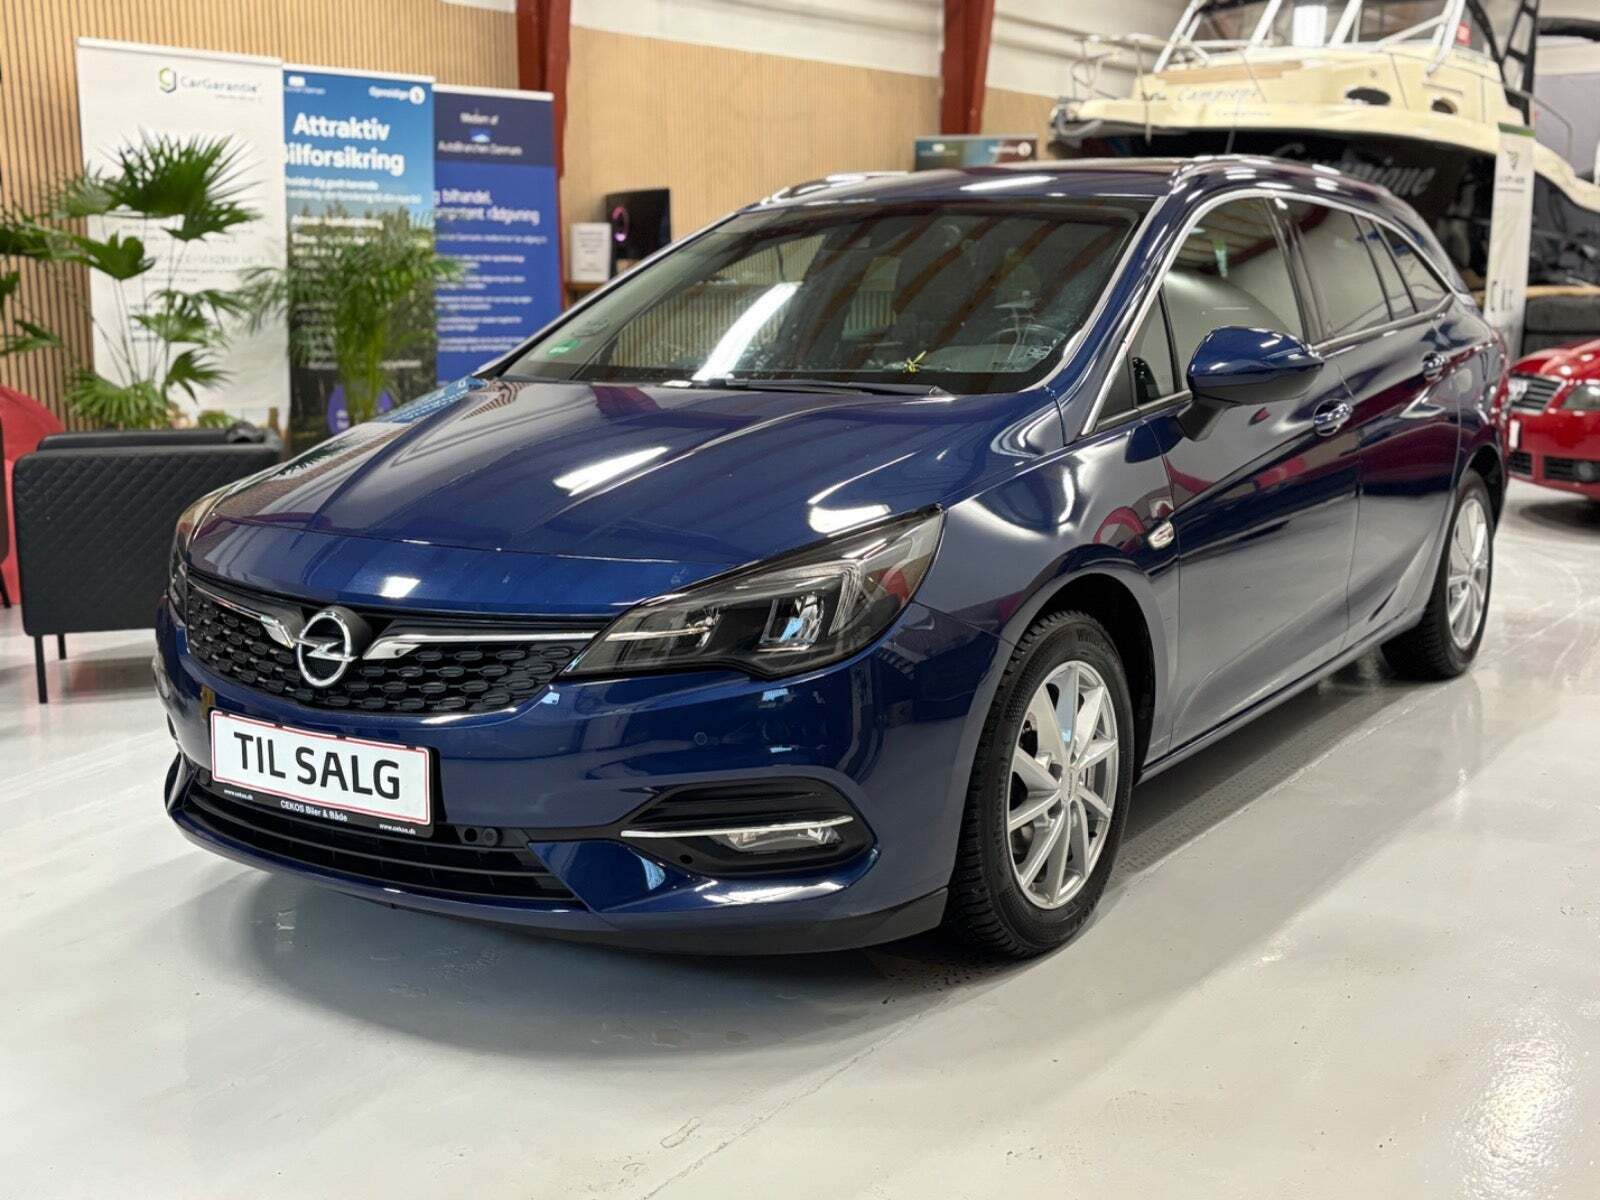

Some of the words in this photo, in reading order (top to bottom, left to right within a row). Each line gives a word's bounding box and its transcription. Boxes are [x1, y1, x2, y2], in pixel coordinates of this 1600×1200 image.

[293, 112, 391, 141] Attraktiv
[234, 731, 286, 780] TIL
[295, 746, 400, 800] SALG
